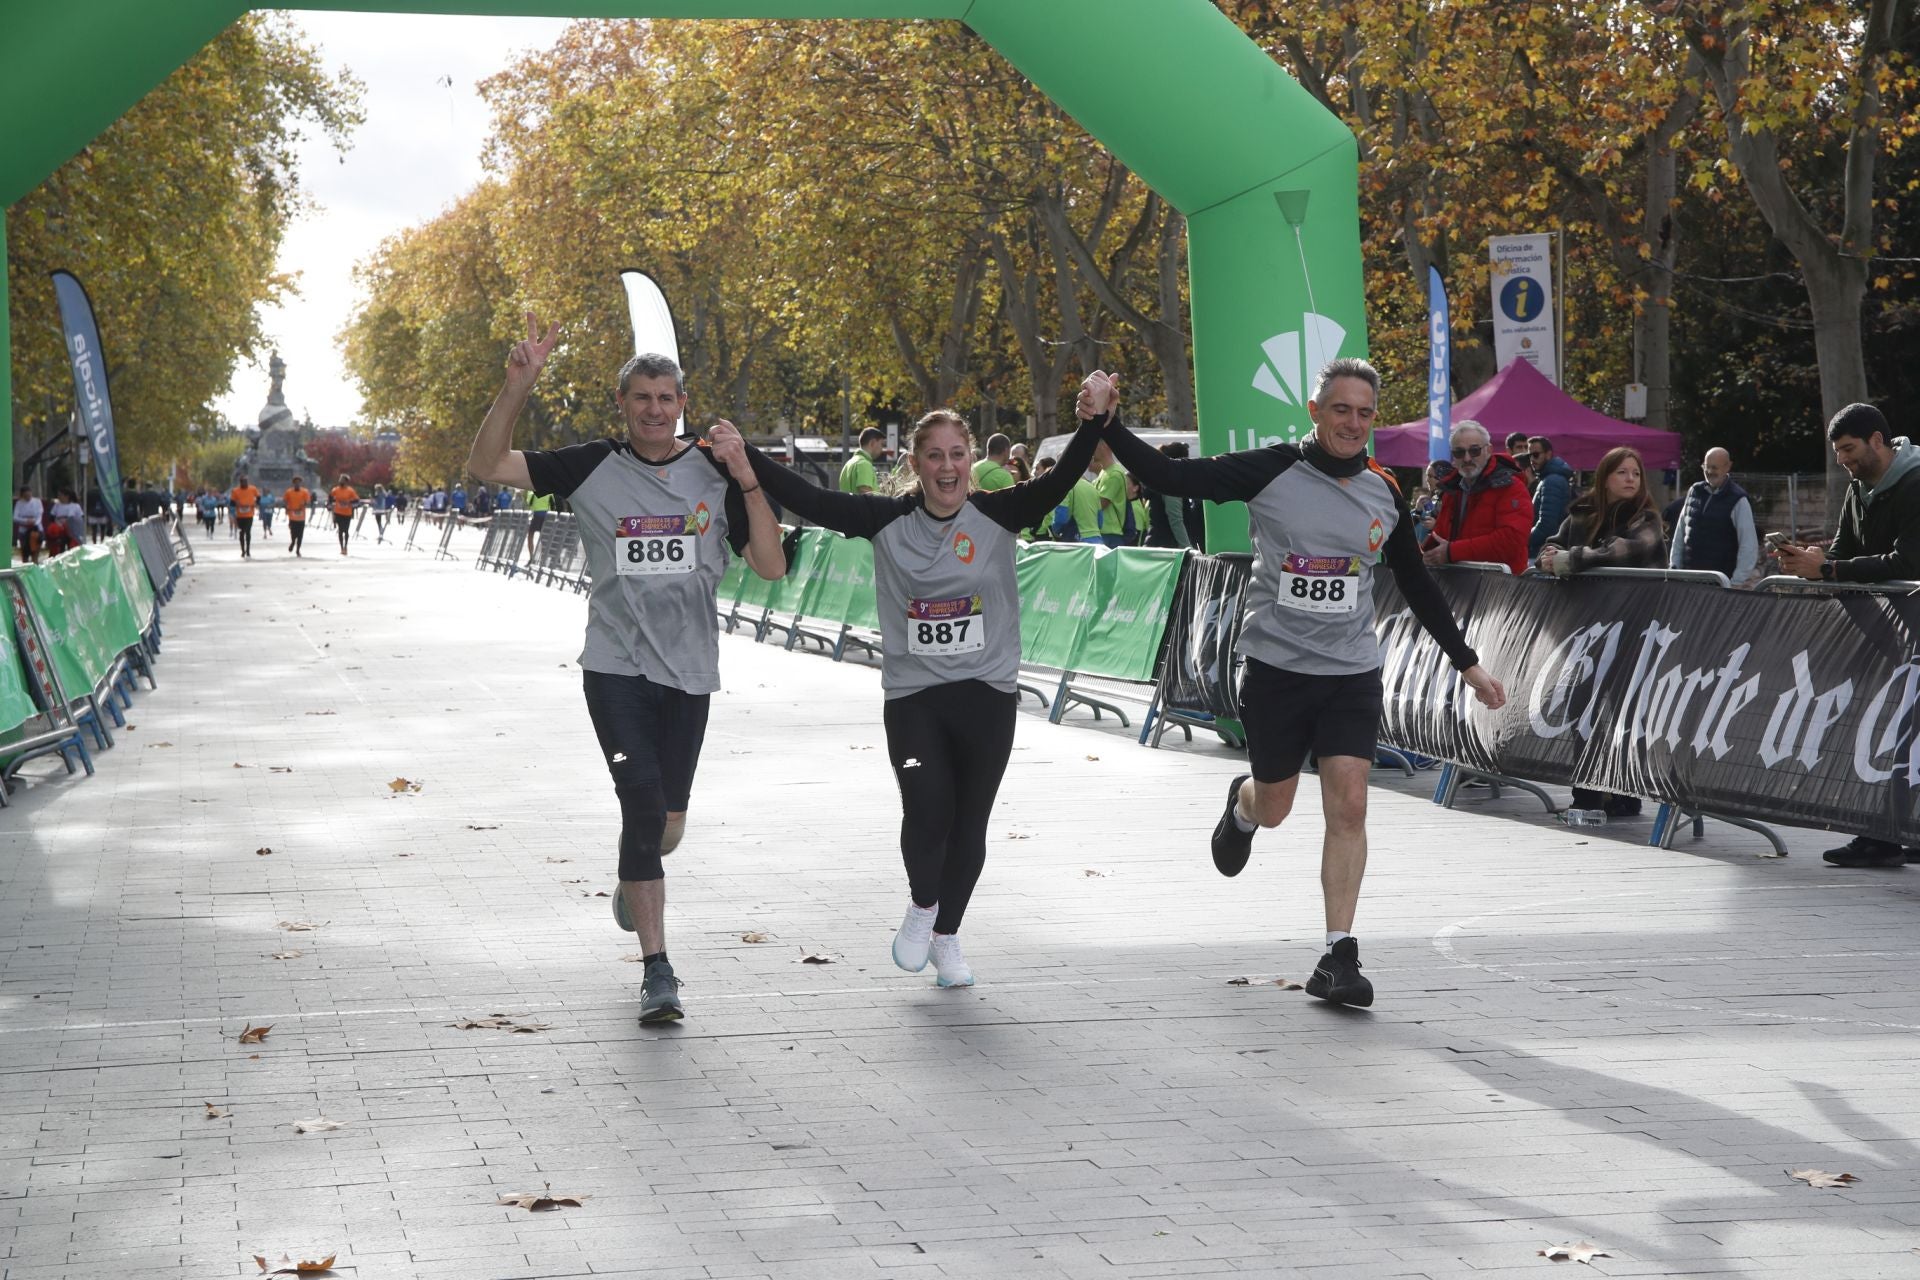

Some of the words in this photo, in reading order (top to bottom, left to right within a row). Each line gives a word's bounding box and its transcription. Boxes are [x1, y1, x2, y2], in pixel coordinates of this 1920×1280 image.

[1496, 244, 1522, 253] Oficina
[1523, 243, 1533, 251] de
[1228, 424, 1297, 454] Uni
[627, 538, 684, 563] 886
[1290, 576, 1345, 602] 888
[917, 619, 971, 645] 887
[1528, 620, 1624, 742] El
[1612, 619, 1761, 762] Norte
[1756, 649, 1854, 773] de
[1853, 654, 1920, 790] C
